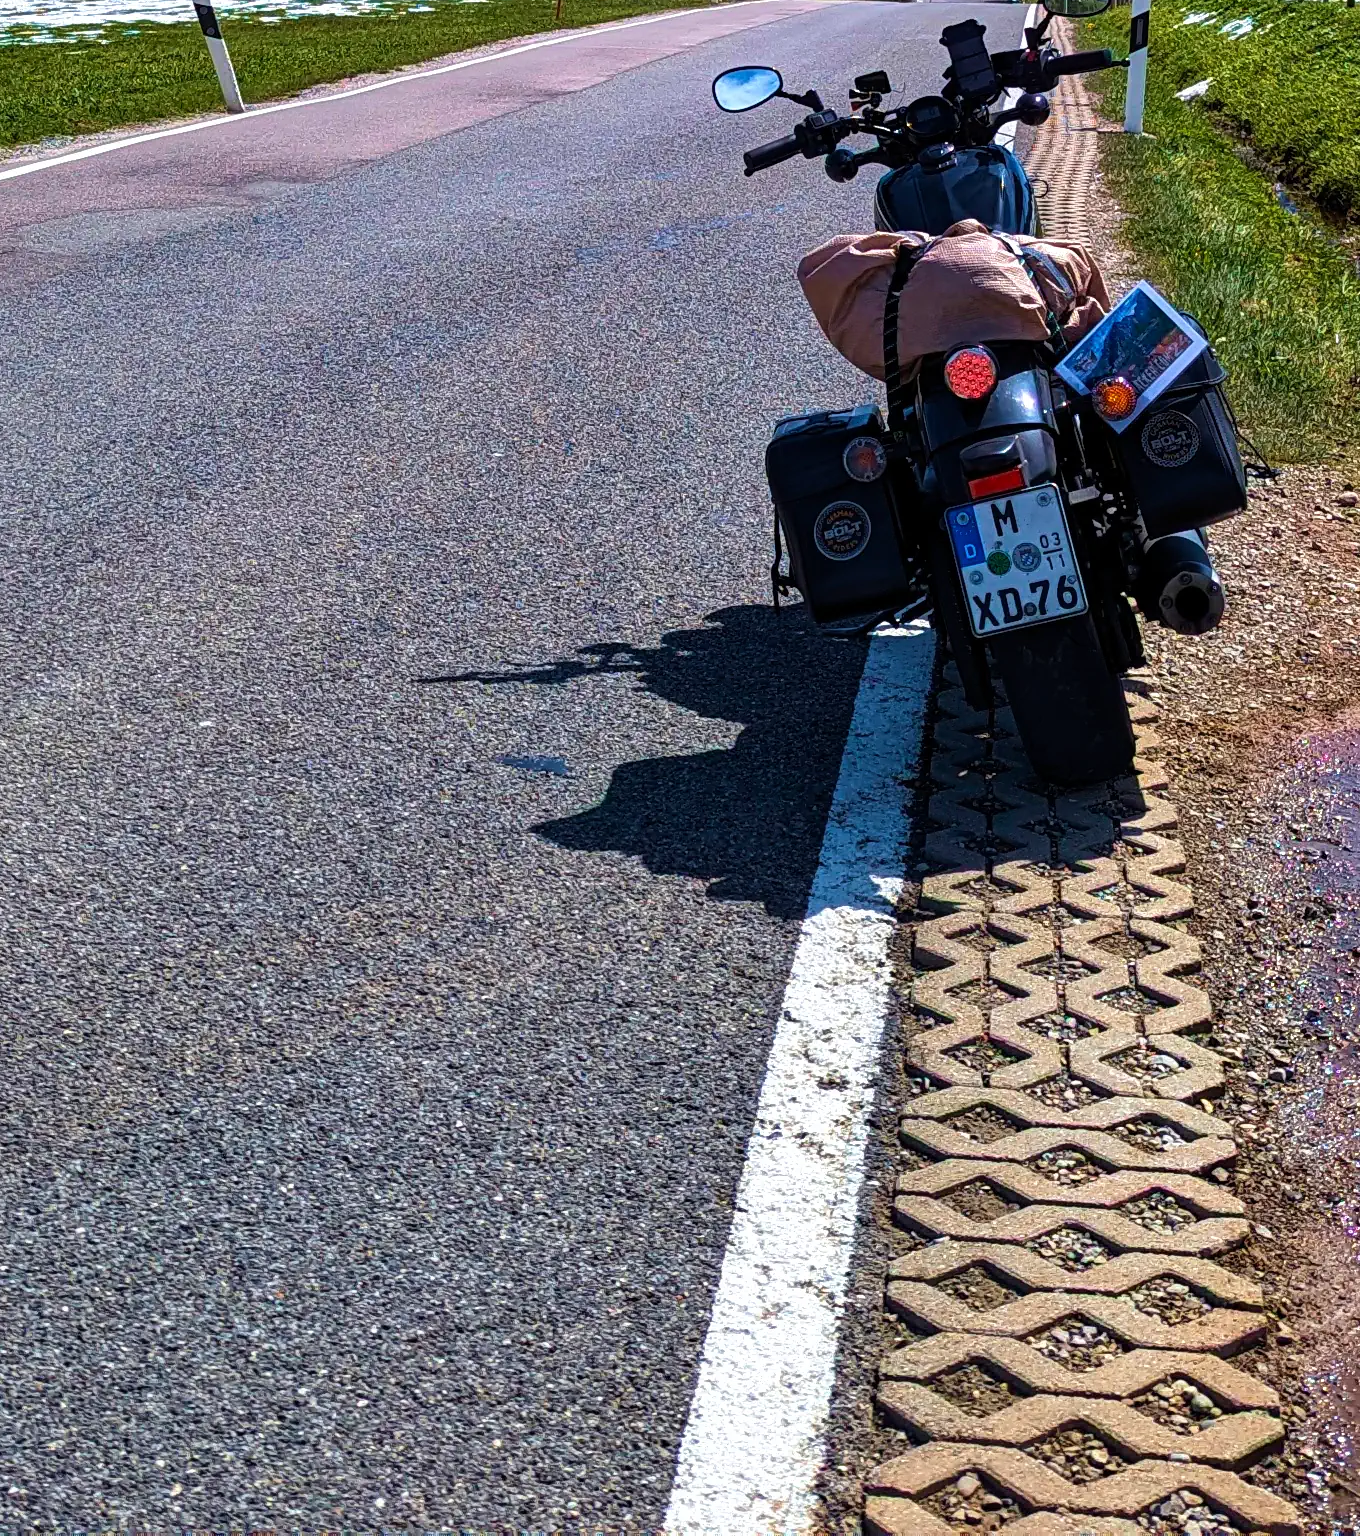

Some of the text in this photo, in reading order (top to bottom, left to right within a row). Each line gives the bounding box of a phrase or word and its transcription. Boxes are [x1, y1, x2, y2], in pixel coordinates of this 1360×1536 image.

[1151, 430, 1188, 450] BOLT
[990, 499, 1019, 537] M
[824, 520, 862, 540] BOLT
[1039, 532, 1061, 549] 03
[964, 543, 977, 559] D
[1046, 554, 1066, 570] 11
